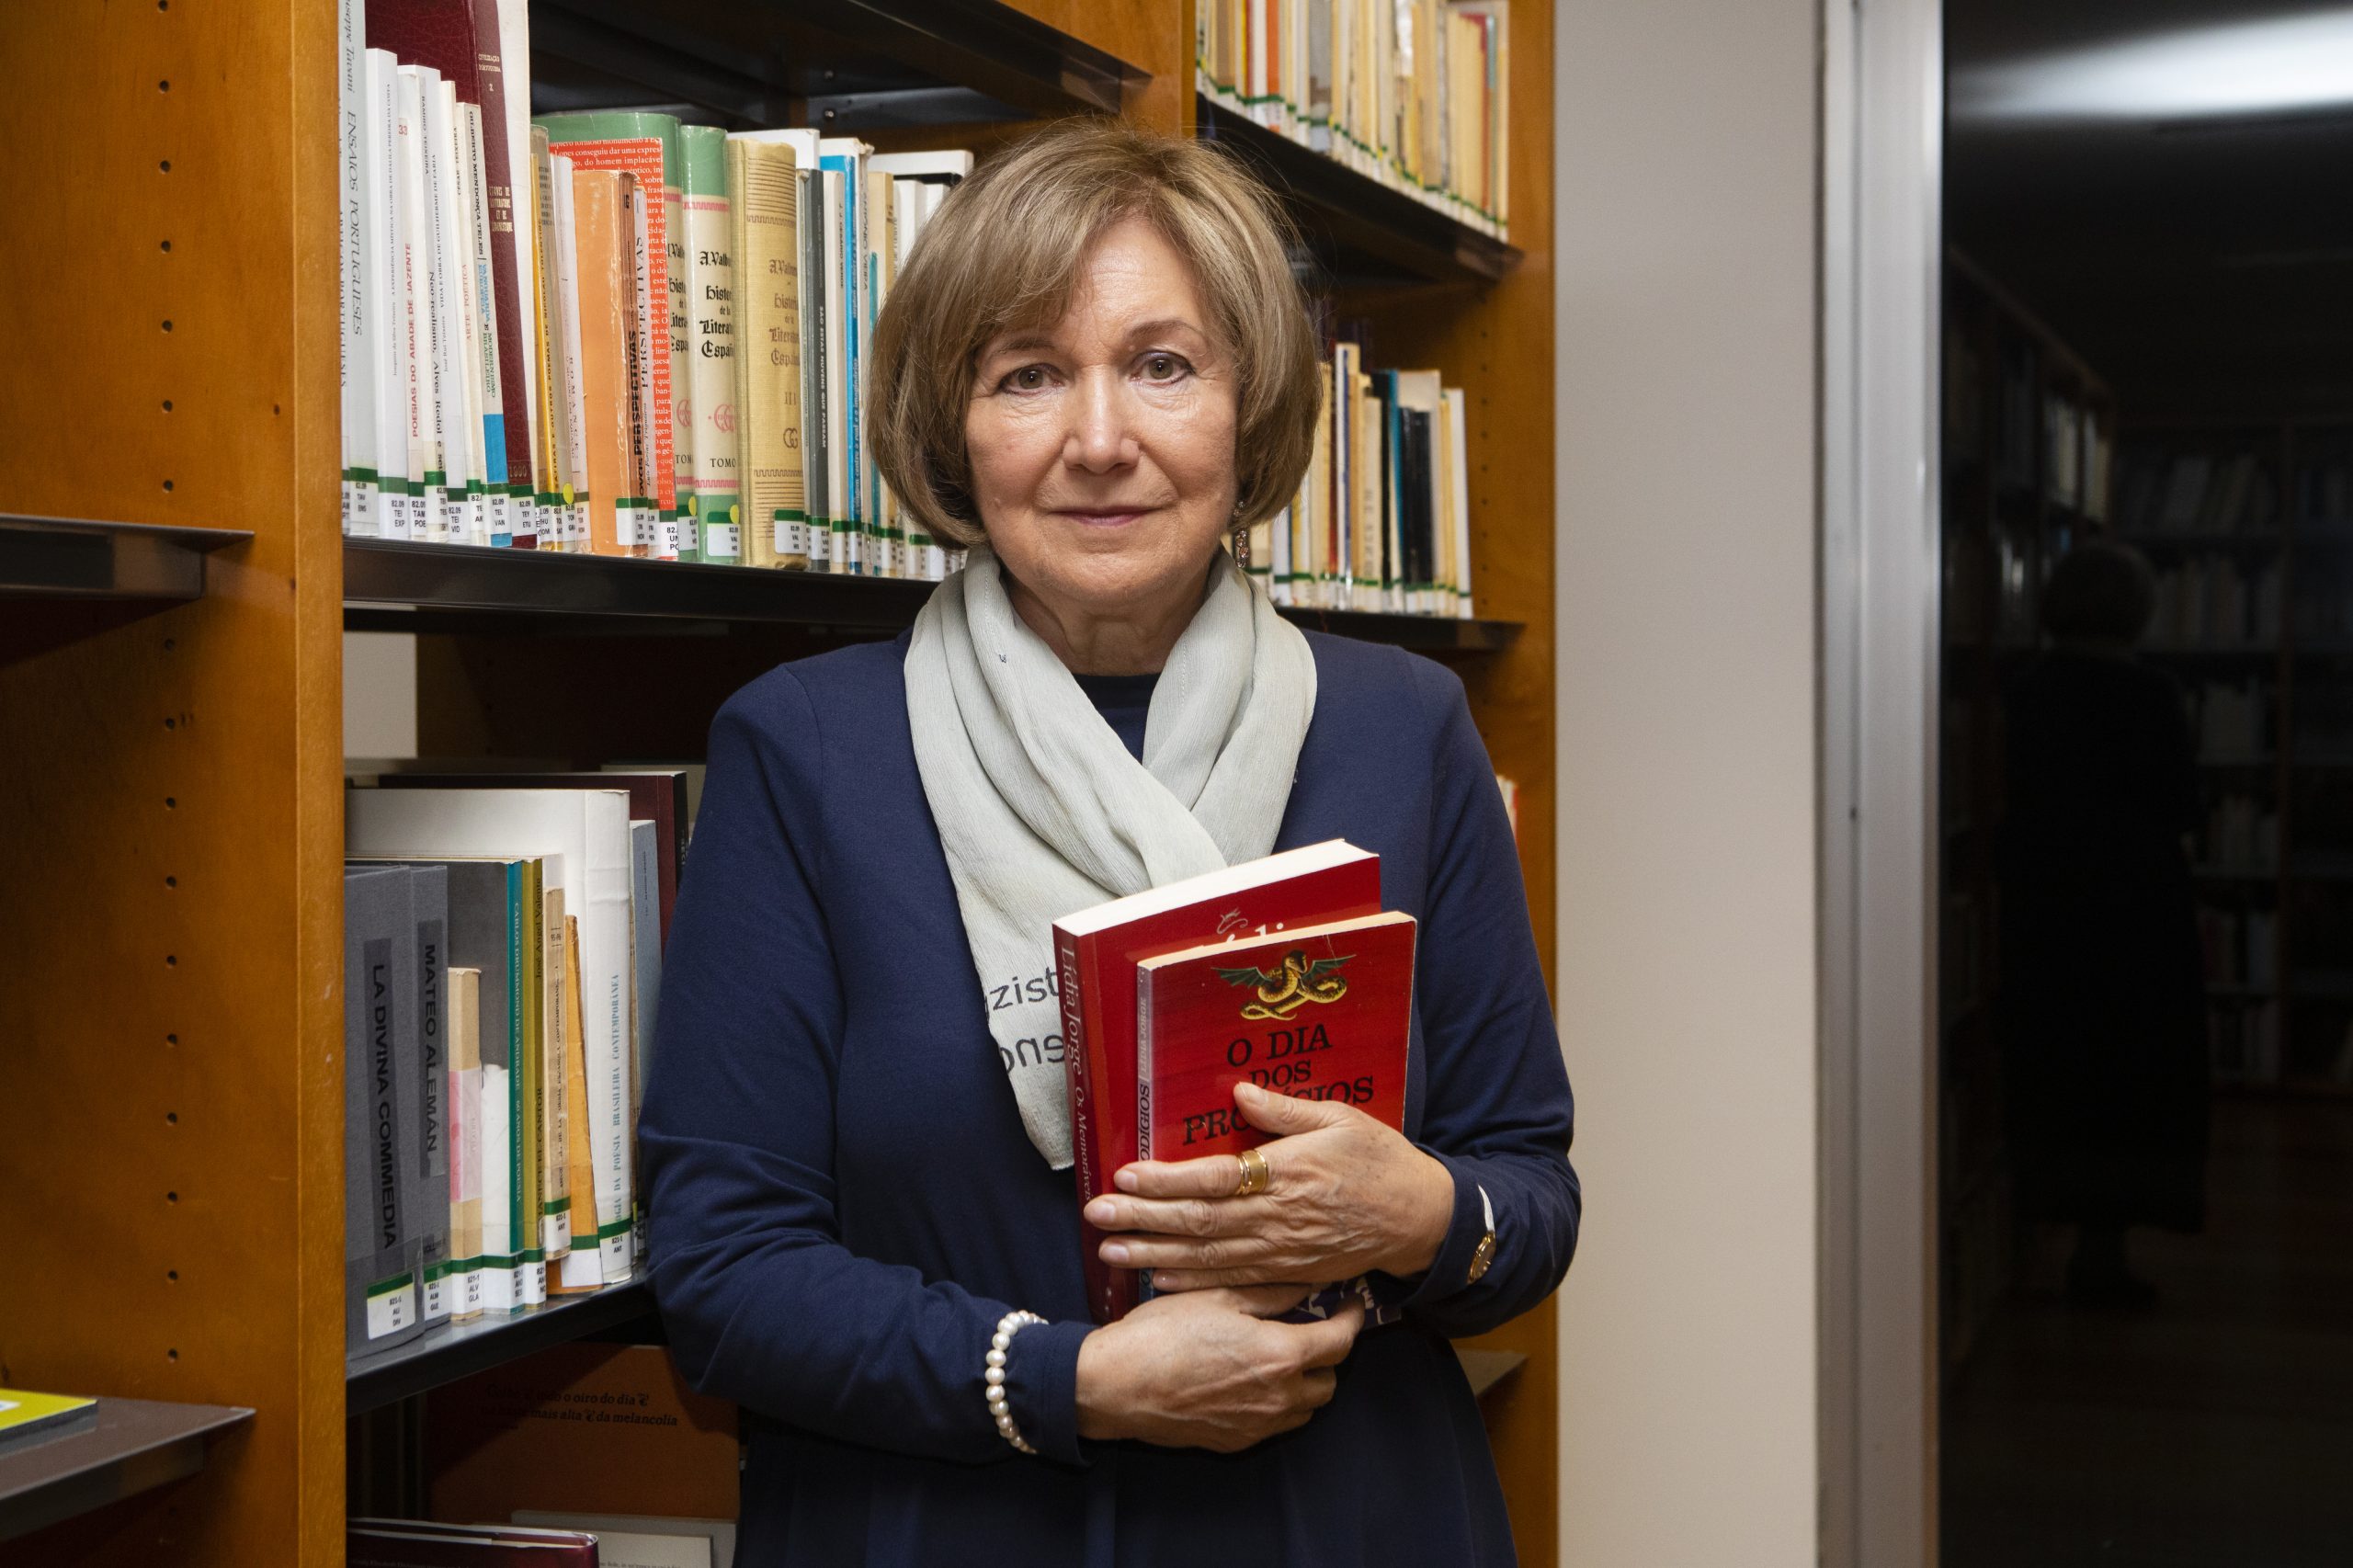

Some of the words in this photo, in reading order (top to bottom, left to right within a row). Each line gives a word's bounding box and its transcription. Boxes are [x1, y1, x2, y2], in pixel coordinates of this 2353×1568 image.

[346, 46, 356, 94] Tavani
[347, 110, 359, 191] ENSAIOS
[469, 110, 477, 161] GILBERTO
[574, 148, 607, 157] conseguiu
[608, 147, 620, 155] dar
[595, 157, 621, 165] homem
[623, 155, 662, 165] implacável
[472, 164, 481, 221] MENDONÇA
[349, 199, 362, 336] PORTUGUESES
[405, 243, 414, 294] JAZENTE
[407, 300, 415, 314] DE
[429, 272, 438, 354] Neo-realismo,
[636, 236, 649, 390] PERSPECTIVAS
[409, 365, 417, 382] DO
[433, 361, 441, 394] Alves
[656, 379, 669, 387] que
[629, 332, 642, 458] PERSPECTIVAS
[655, 397, 670, 406] para
[435, 401, 443, 434] Redol
[710, 458, 736, 468] TOMO
[394, 519, 404, 528] EXP
[534, 877, 543, 918] Valente
[372, 963, 386, 1000] LA
[535, 954, 543, 980] José
[1061, 948, 1079, 1007] Lídia
[425, 943, 438, 1037] MATEO
[514, 1019, 521, 1035] DE
[609, 974, 621, 1062] CONTEMPORÂNEA
[1139, 997, 1148, 1039] JORGE
[374, 1005, 390, 1096] DIVINA
[1063, 1006, 1083, 1075] Jorge
[1139, 1040, 1148, 1073] LÍDIA
[1226, 1038, 1253, 1068] O
[1266, 1023, 1333, 1061] DIA
[514, 1036, 522, 1090] ANDRADE
[1248, 1060, 1312, 1091] DOS
[425, 1044, 440, 1153] ALEMÁN
[535, 1087, 544, 1144] CANTOR
[611, 1067, 622, 1129] BRASILEIRA
[1075, 1086, 1086, 1108] Os
[1182, 1076, 1373, 1148] PROIOS
[515, 1113, 523, 1143] ANOS
[1139, 1084, 1151, 1161] ODÍGIOS
[515, 1144, 523, 1160] DE
[612, 1135, 623, 1174] POESIA
[1076, 1111, 1092, 1201] Memoráveis
[378, 1101, 397, 1250] COMMEDIA
[515, 1163, 524, 1202] POESIA
[612, 1180, 623, 1193] DA
[613, 1245, 622, 1254] ANT
[467, 1274, 479, 1284] 821-1
[468, 1294, 479, 1302] GLA
[469, 1284, 479, 1293] ALV
[530, 1408, 559, 1420] mais
[559, 1409, 583, 1422] alta
[597, 1413, 610, 1423] da
[612, 1413, 678, 1426] melancolia
[573, 1392, 599, 1404] oiro
[599, 1392, 615, 1404] do
[617, 1392, 636, 1406] dia
